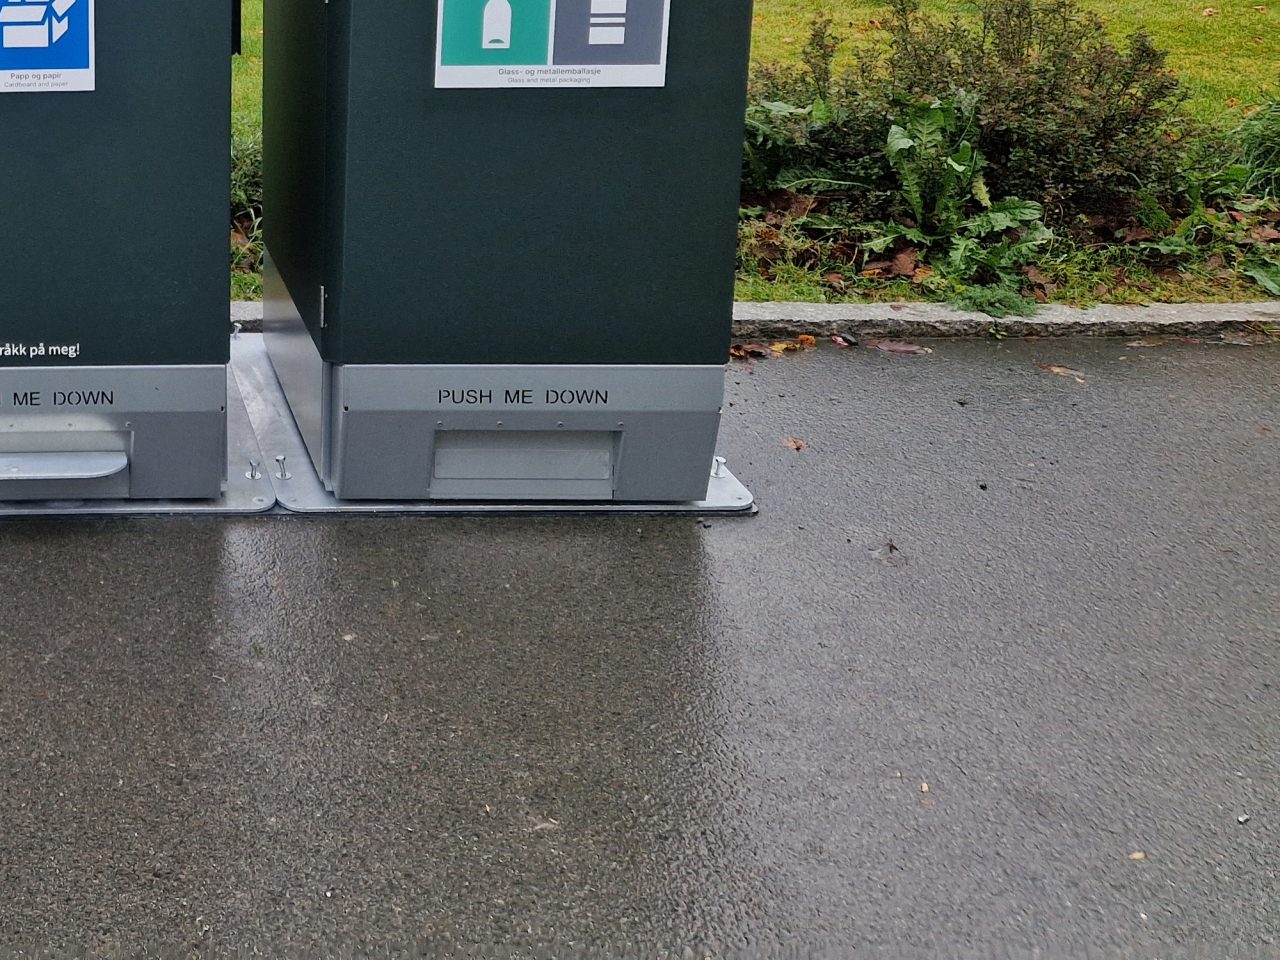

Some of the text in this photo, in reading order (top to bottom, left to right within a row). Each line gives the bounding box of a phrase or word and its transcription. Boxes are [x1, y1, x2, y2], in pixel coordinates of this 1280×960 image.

[10, 72, 30, 80] Papp
[42, 72, 62, 80] papir
[536, 67, 601, 75] metallemballasje
[29, 342, 45, 358] på
[48, 342, 80, 358] meg!
[13, 391, 41, 406] ME
[53, 390, 114, 406] DOWN
[438, 389, 608, 405] PUSH ME DOWN
